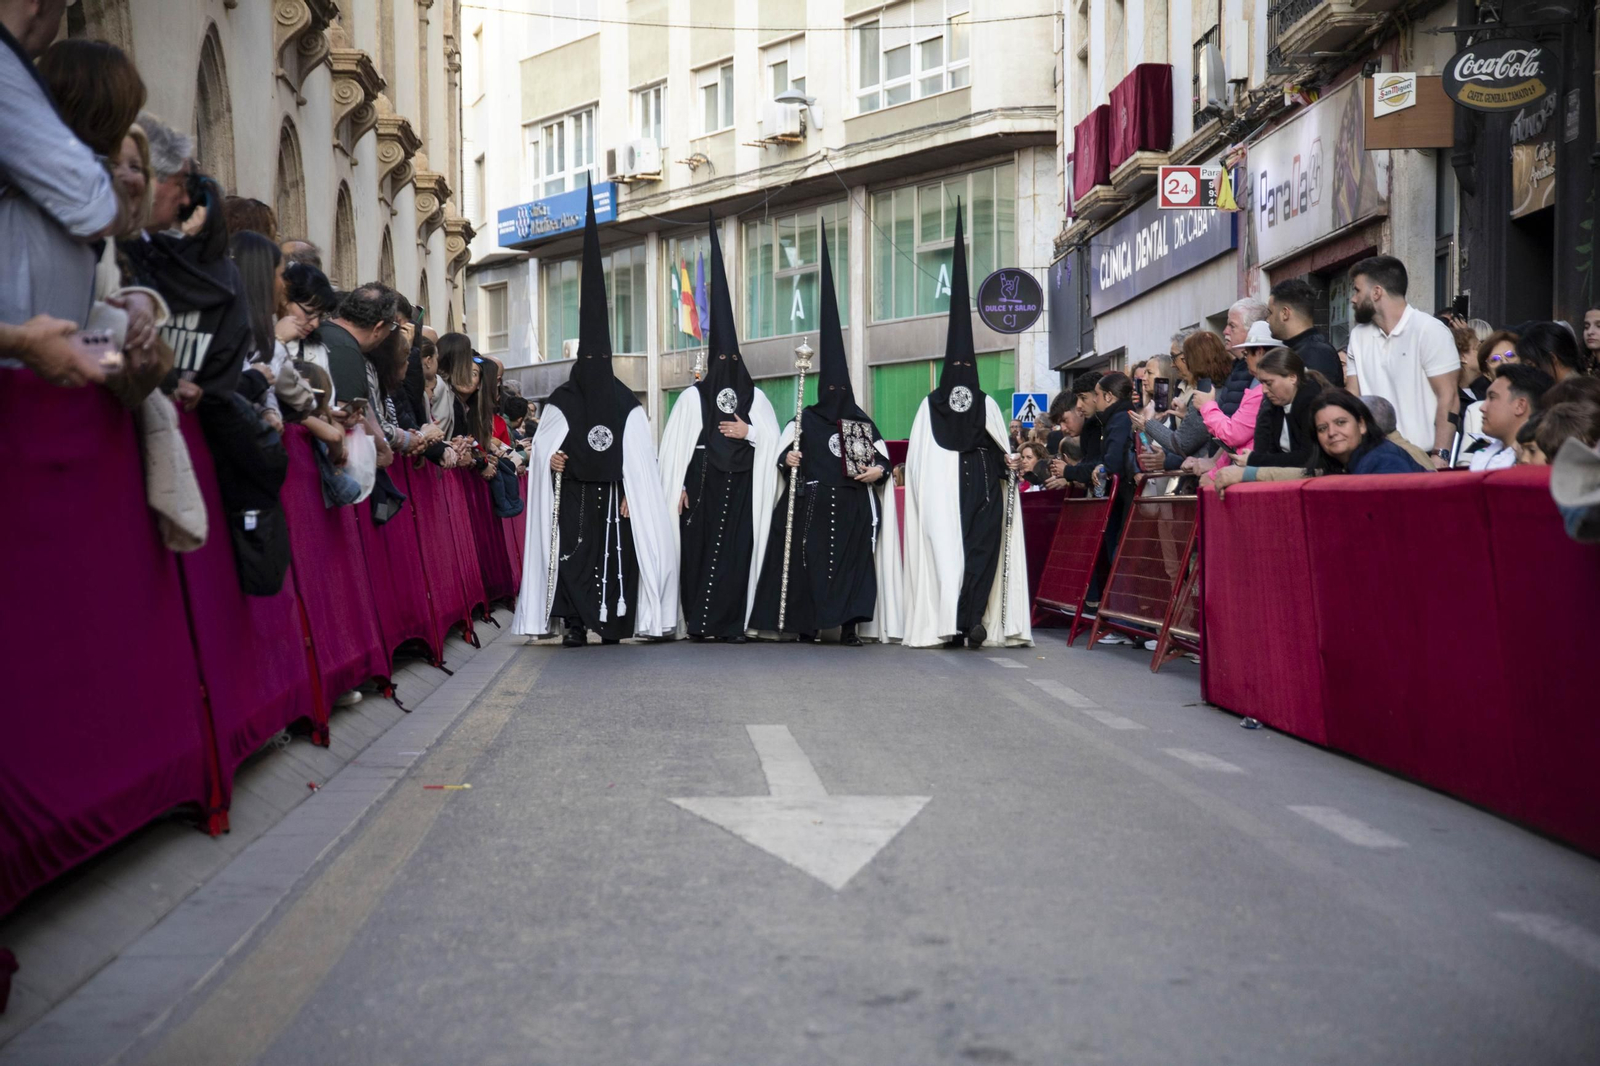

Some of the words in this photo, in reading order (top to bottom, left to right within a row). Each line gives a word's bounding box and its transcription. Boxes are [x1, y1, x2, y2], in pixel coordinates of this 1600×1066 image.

[1484, 92, 1508, 103] GENERAL
[1168, 179, 1194, 194] 24h
[1135, 215, 1168, 272] DENTAL
[1174, 215, 1187, 250] DR.
[1003, 314, 1017, 327] CJ
